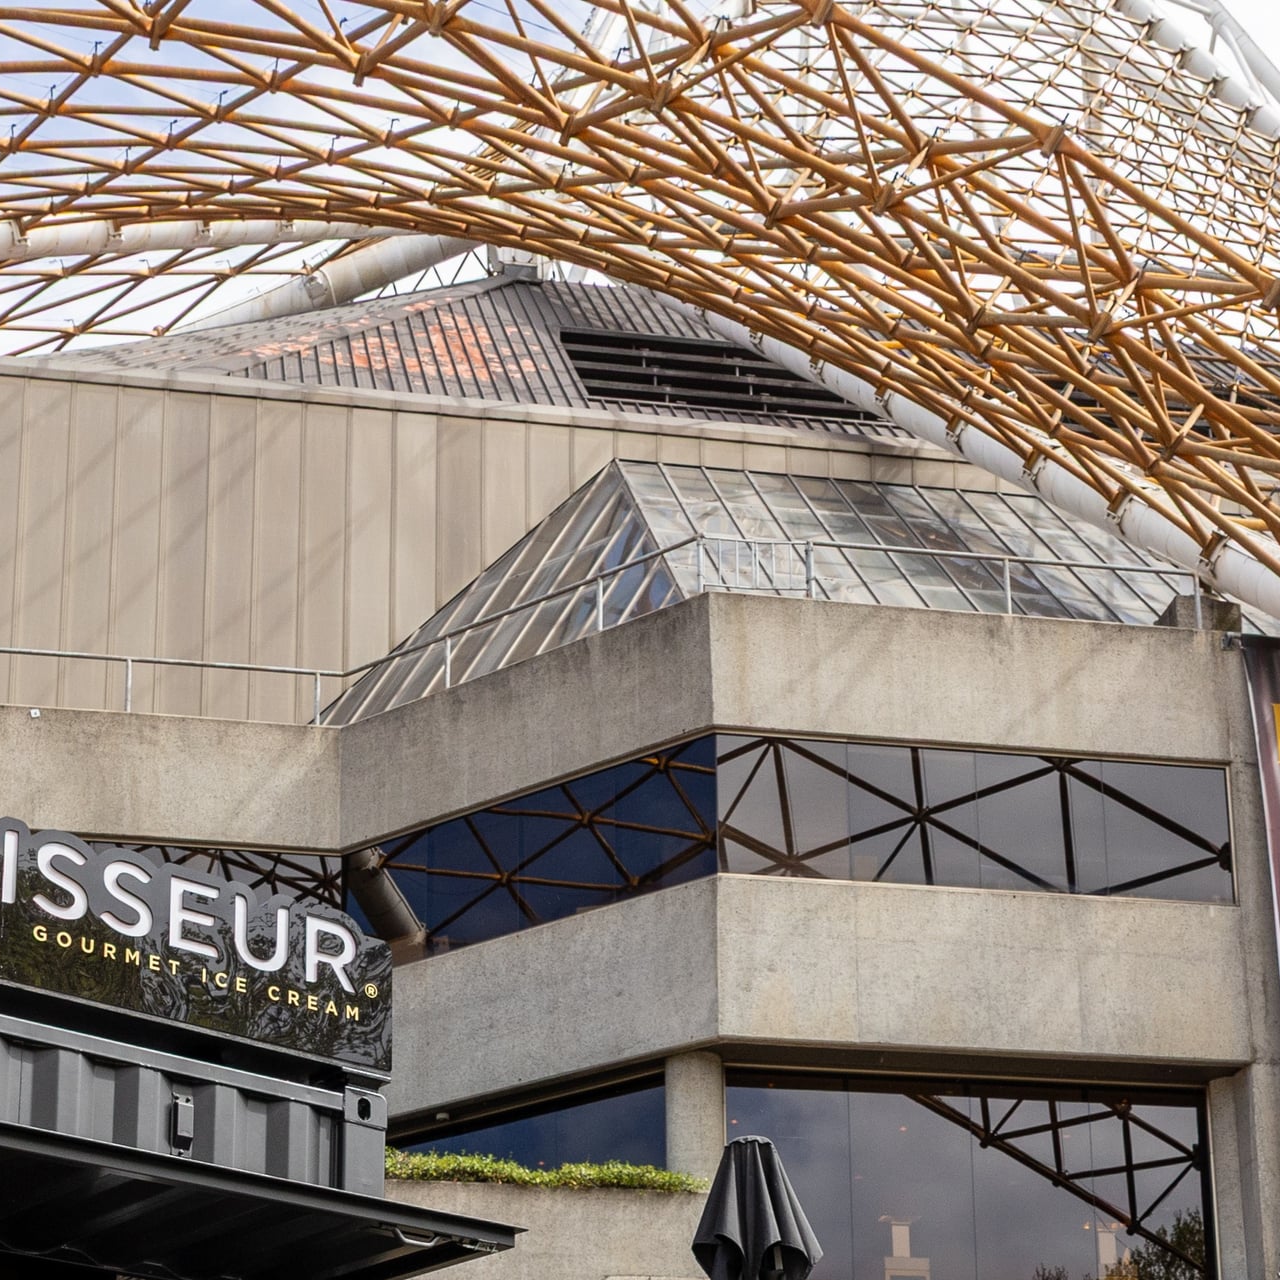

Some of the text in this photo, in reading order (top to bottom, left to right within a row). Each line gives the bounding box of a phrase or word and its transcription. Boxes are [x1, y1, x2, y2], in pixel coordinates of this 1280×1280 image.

[32, 925, 360, 1021] GOURMET ICE CREAM
